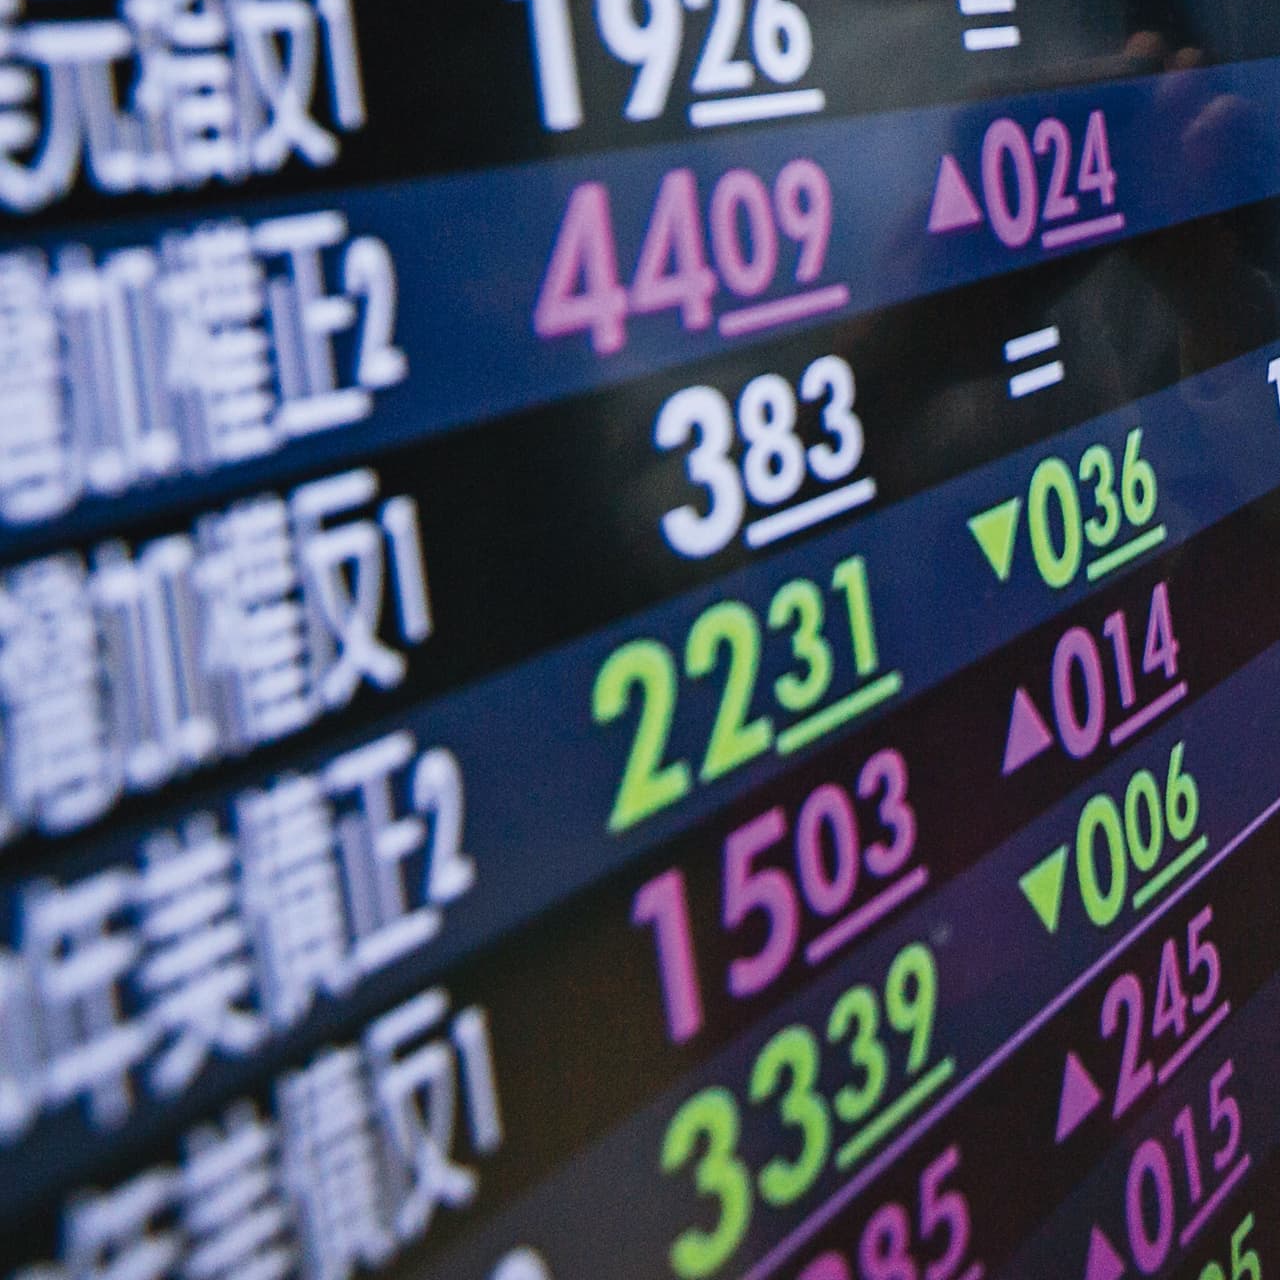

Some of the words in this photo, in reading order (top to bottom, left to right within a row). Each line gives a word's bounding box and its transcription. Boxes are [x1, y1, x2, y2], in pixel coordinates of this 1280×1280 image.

[534, 159, 833, 356] 4409
[981, 109, 1118, 248] 024
[655, 354, 865, 557] 383
[592, 555, 878, 832] 2231
[1027, 428, 1158, 588] 036
[631, 747, 919, 1045] 1503
[1051, 581, 1180, 759] 014
[661, 942, 939, 1280] 3339
[1075, 741, 1199, 926] 006
[1101, 906, 1223, 1120] 245
[1126, 1059, 1243, 1274] 015
